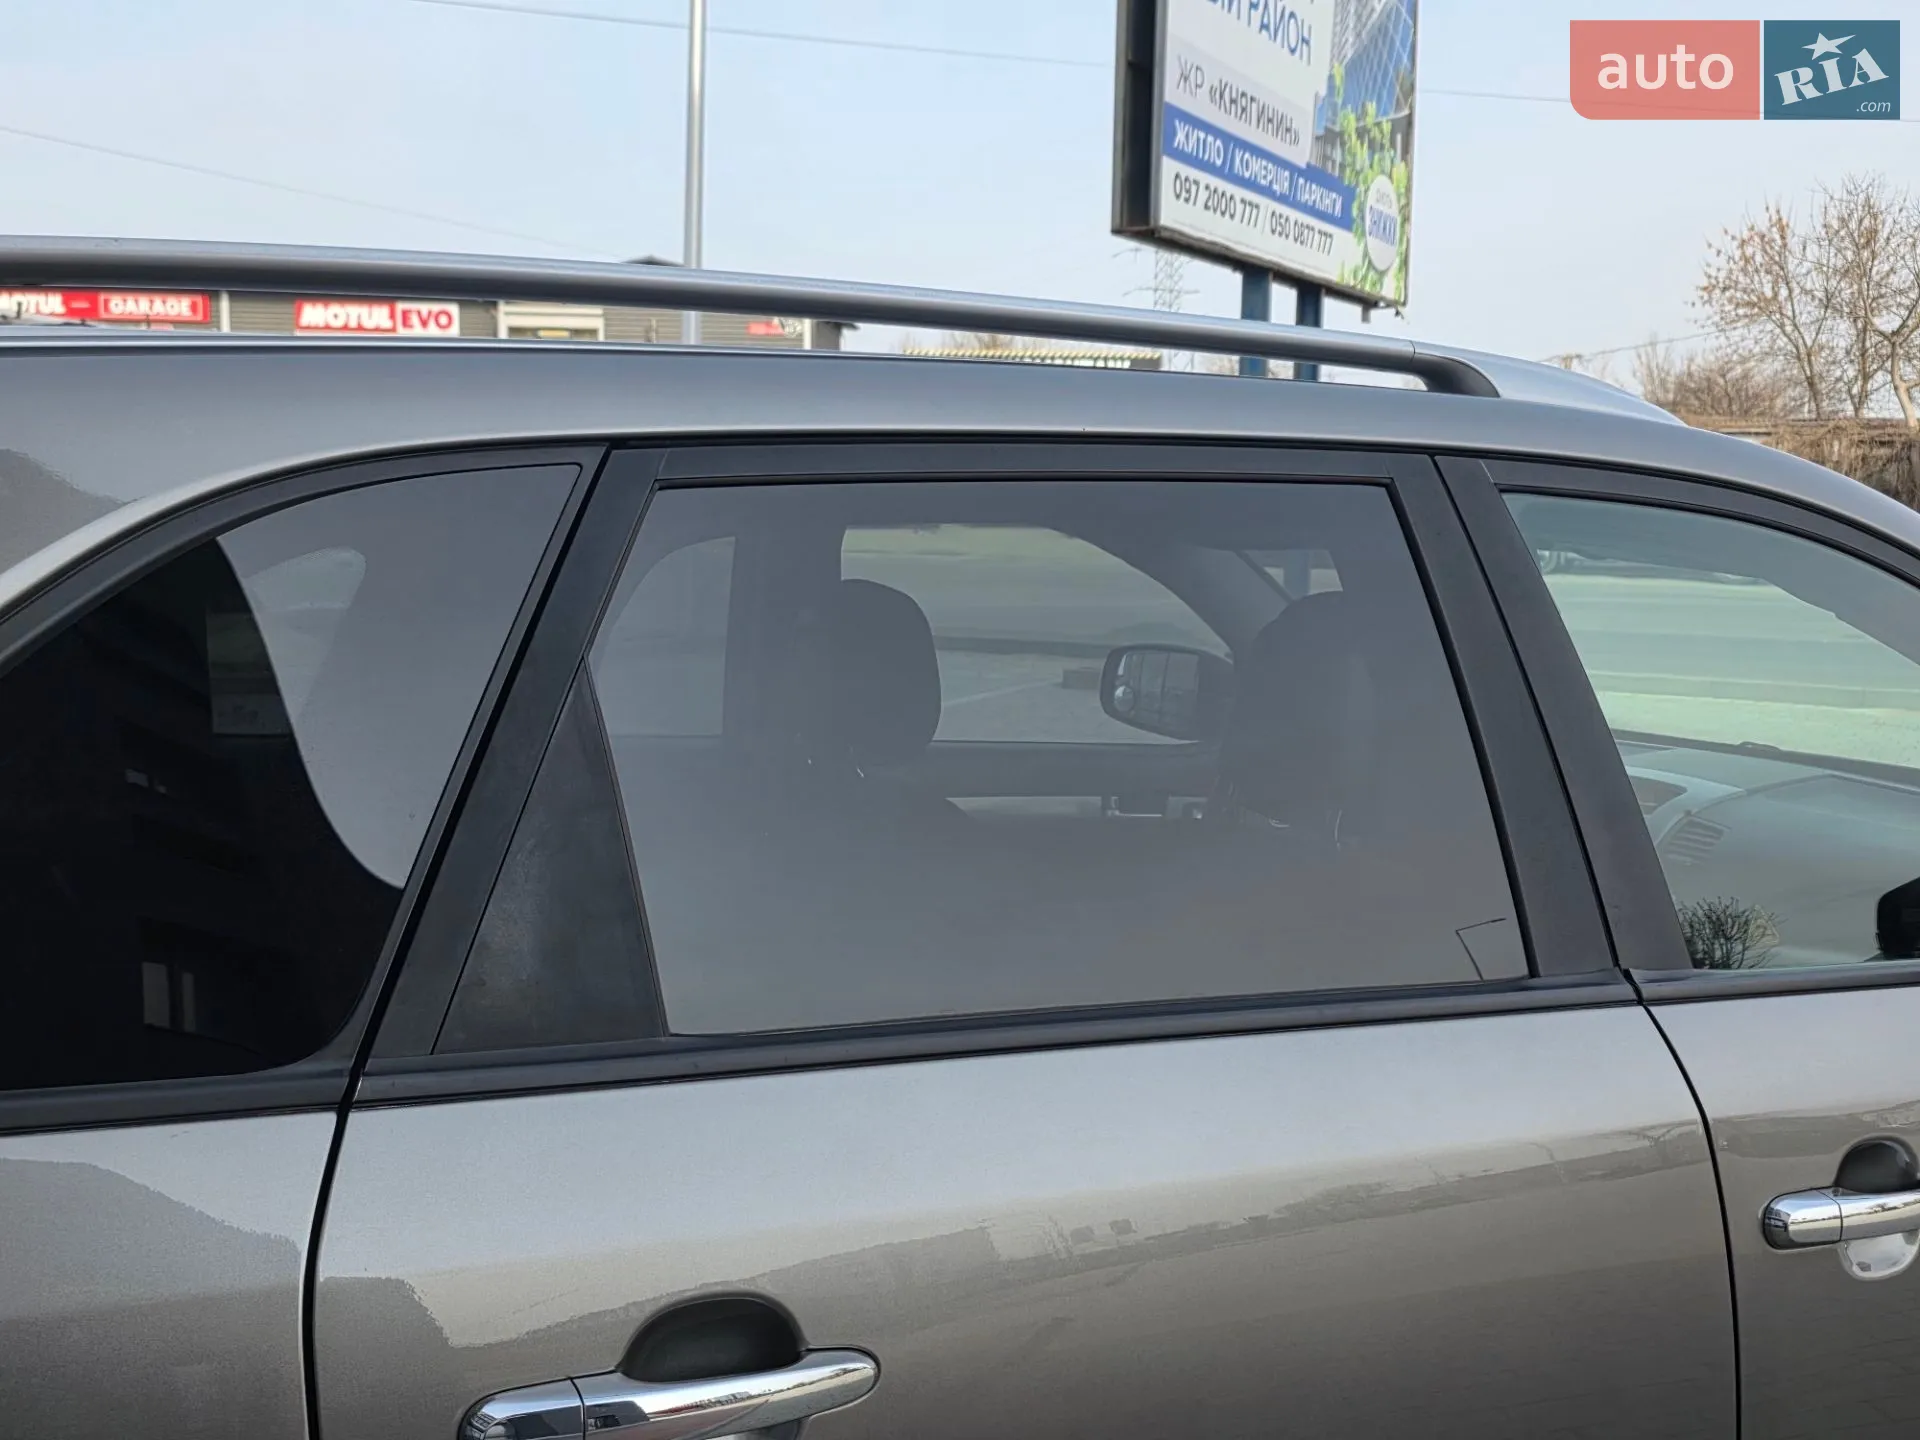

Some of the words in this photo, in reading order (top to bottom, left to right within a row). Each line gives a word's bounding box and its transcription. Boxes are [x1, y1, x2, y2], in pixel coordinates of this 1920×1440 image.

[1176, 54, 1205, 98] ЖР
[1209, 78, 1300, 147] «КНЯГИНИН»
[1173, 118, 1224, 168] ЖИТЛО
[1235, 147, 1291, 197] КОМЕРЦІЯ
[1297, 176, 1343, 218] ПАРКІНГИ
[1173, 171, 1200, 206] 097
[1204, 183, 1237, 220] 2000
[1240, 197, 1260, 228] 777
[1270, 209, 1291, 241] 050
[1293, 218, 1315, 250] 0877
[1317, 228, 1334, 256] 777
[108, 294, 193, 317] GARAGE
[299, 302, 394, 330] MOTUL
[401, 309, 453, 330] EVO
